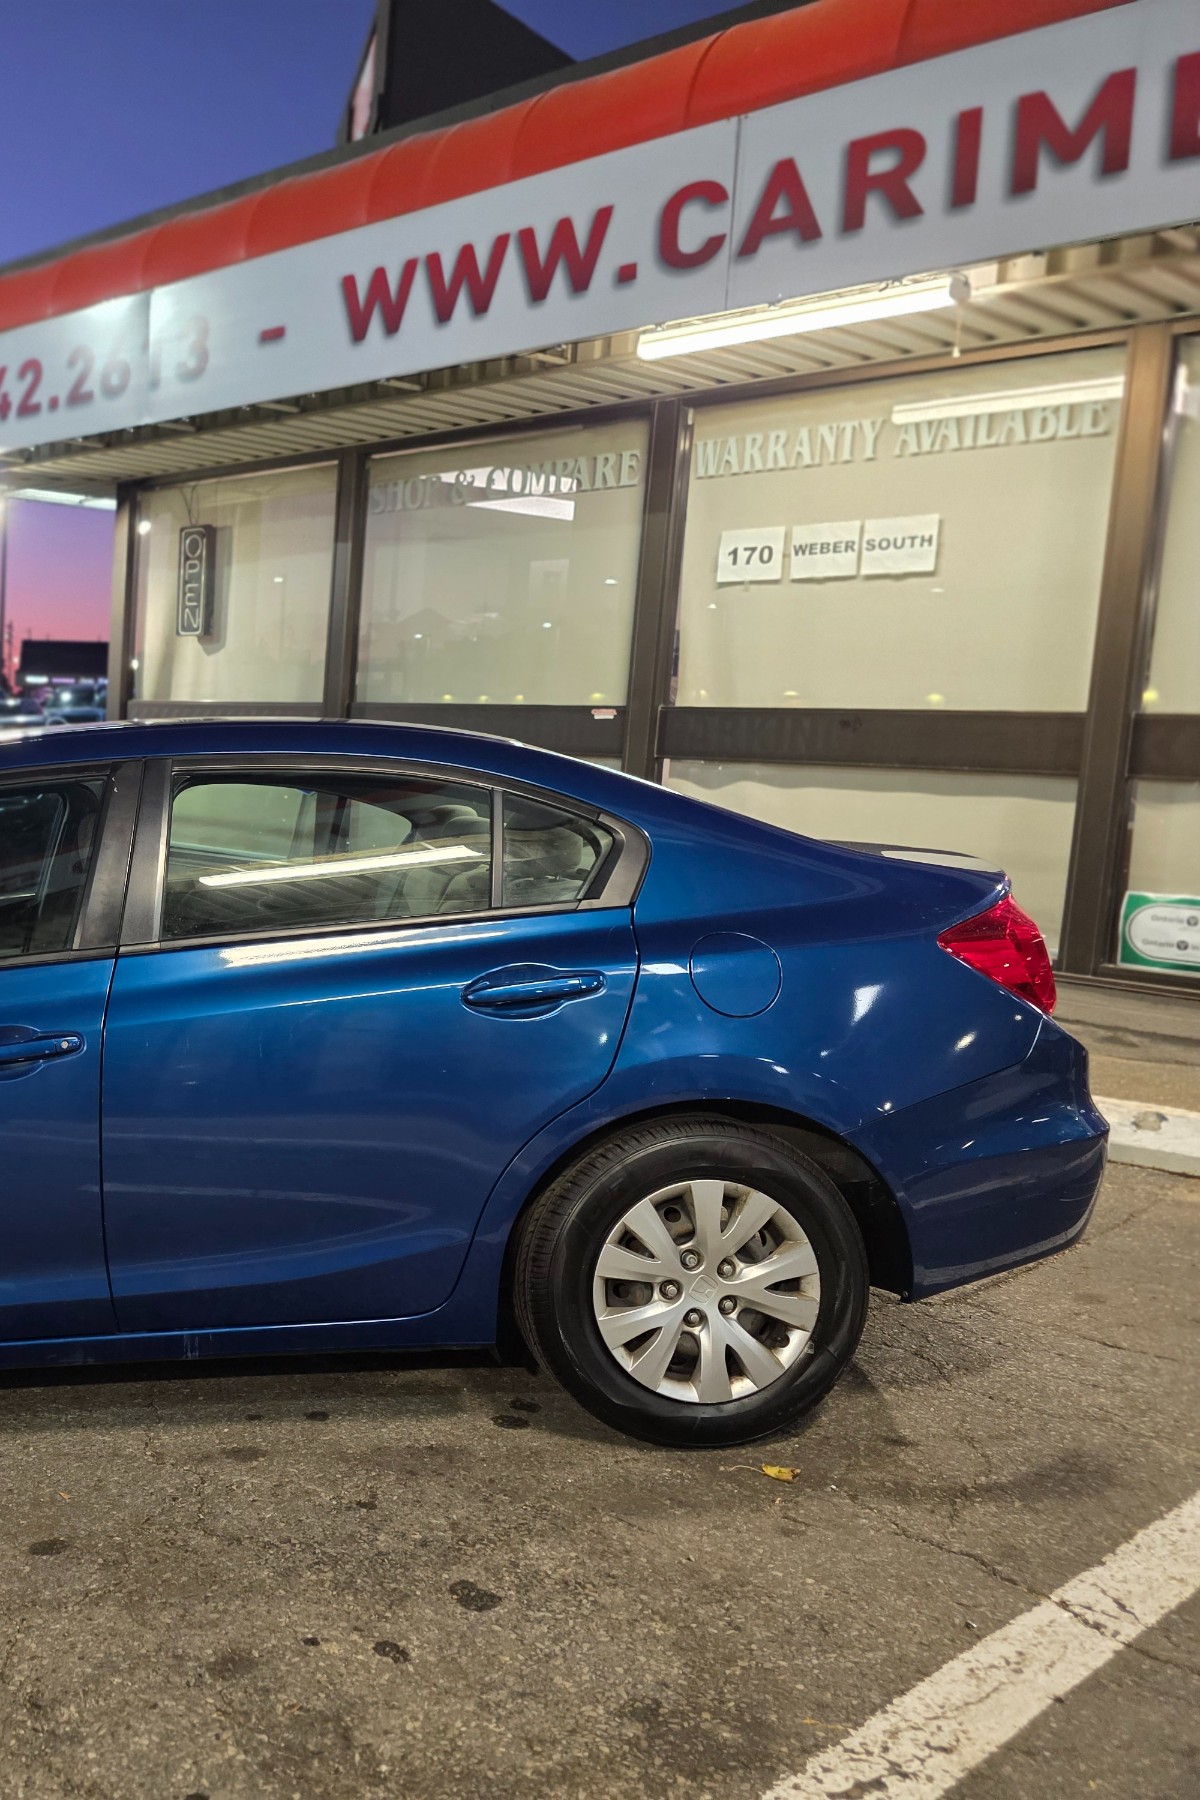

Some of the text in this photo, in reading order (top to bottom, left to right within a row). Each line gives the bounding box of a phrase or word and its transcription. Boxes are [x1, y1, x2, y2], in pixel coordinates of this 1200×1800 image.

[695, 399, 1111, 479] WARRANTY AVAILABLE
[370, 450, 641, 515] SHOP & COMPARE
[182, 533, 202, 631] OPEN
[726, 532, 934, 567] 170 WEBER SOUTH
